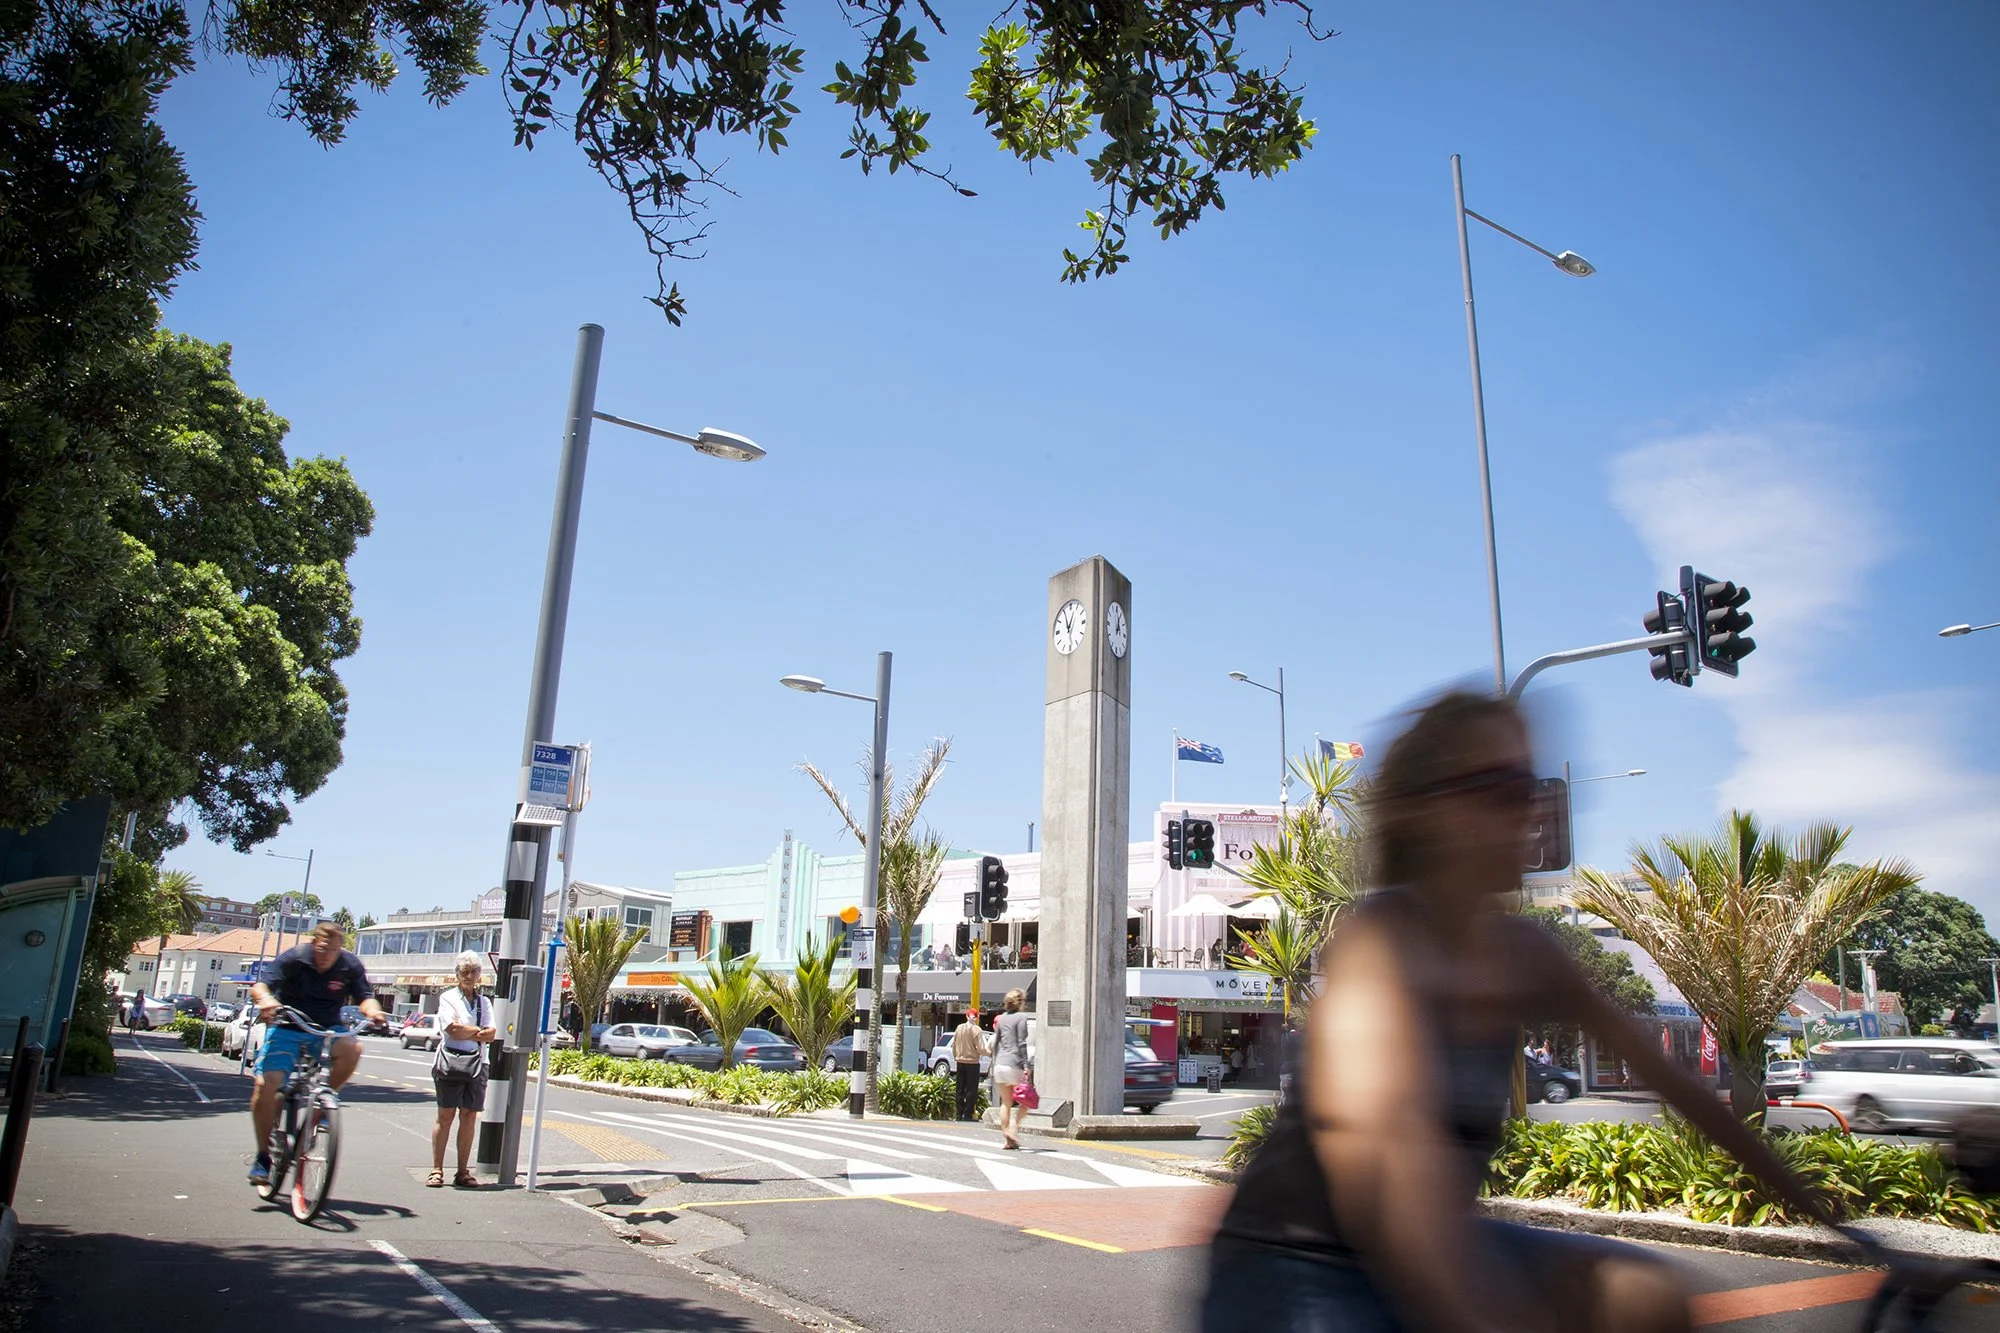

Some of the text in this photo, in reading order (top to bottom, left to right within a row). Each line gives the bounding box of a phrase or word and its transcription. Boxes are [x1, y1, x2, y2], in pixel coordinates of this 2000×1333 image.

[536, 751, 556, 760] 7328
[1224, 843, 1253, 861] Fo
[779, 834, 792, 942] BERKELEY
[481, 896, 505, 909] masal
[1654, 1005, 1686, 1016] nvenience
